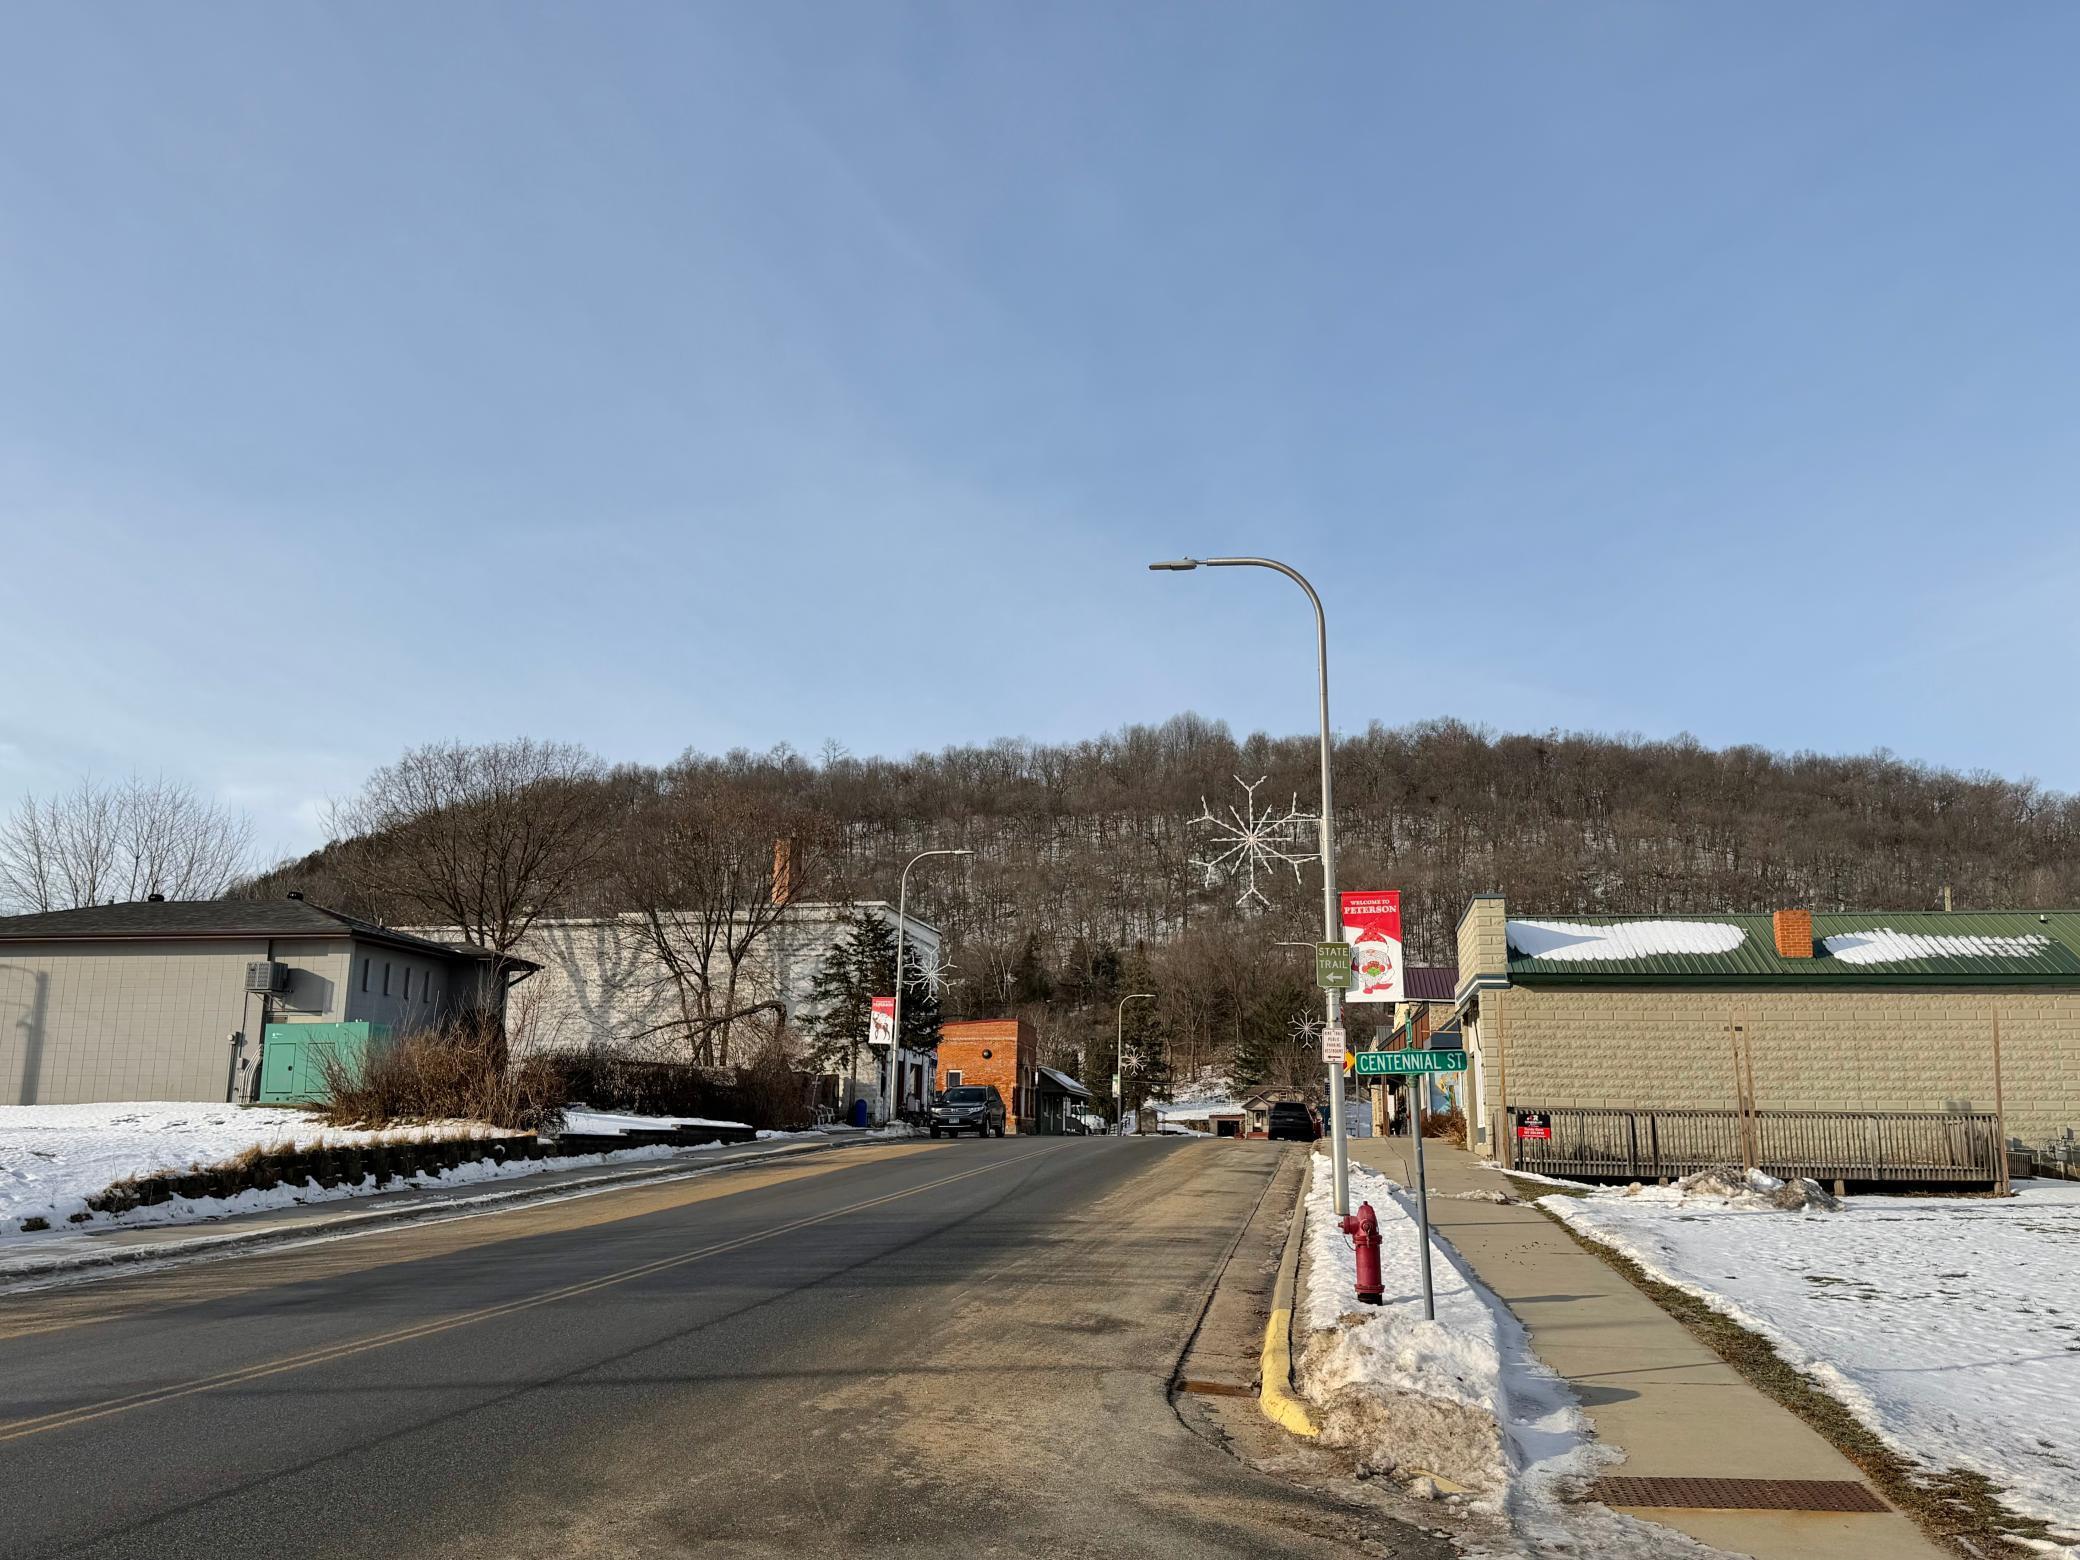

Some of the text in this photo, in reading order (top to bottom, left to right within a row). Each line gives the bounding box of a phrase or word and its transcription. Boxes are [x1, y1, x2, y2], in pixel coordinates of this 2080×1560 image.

[1344, 905, 1397, 914] PETERSON
[1318, 947, 1349, 956] STATE
[1319, 959, 1348, 968] TRAIL
[1360, 1053, 1463, 1071] CENTENNIAL ST
